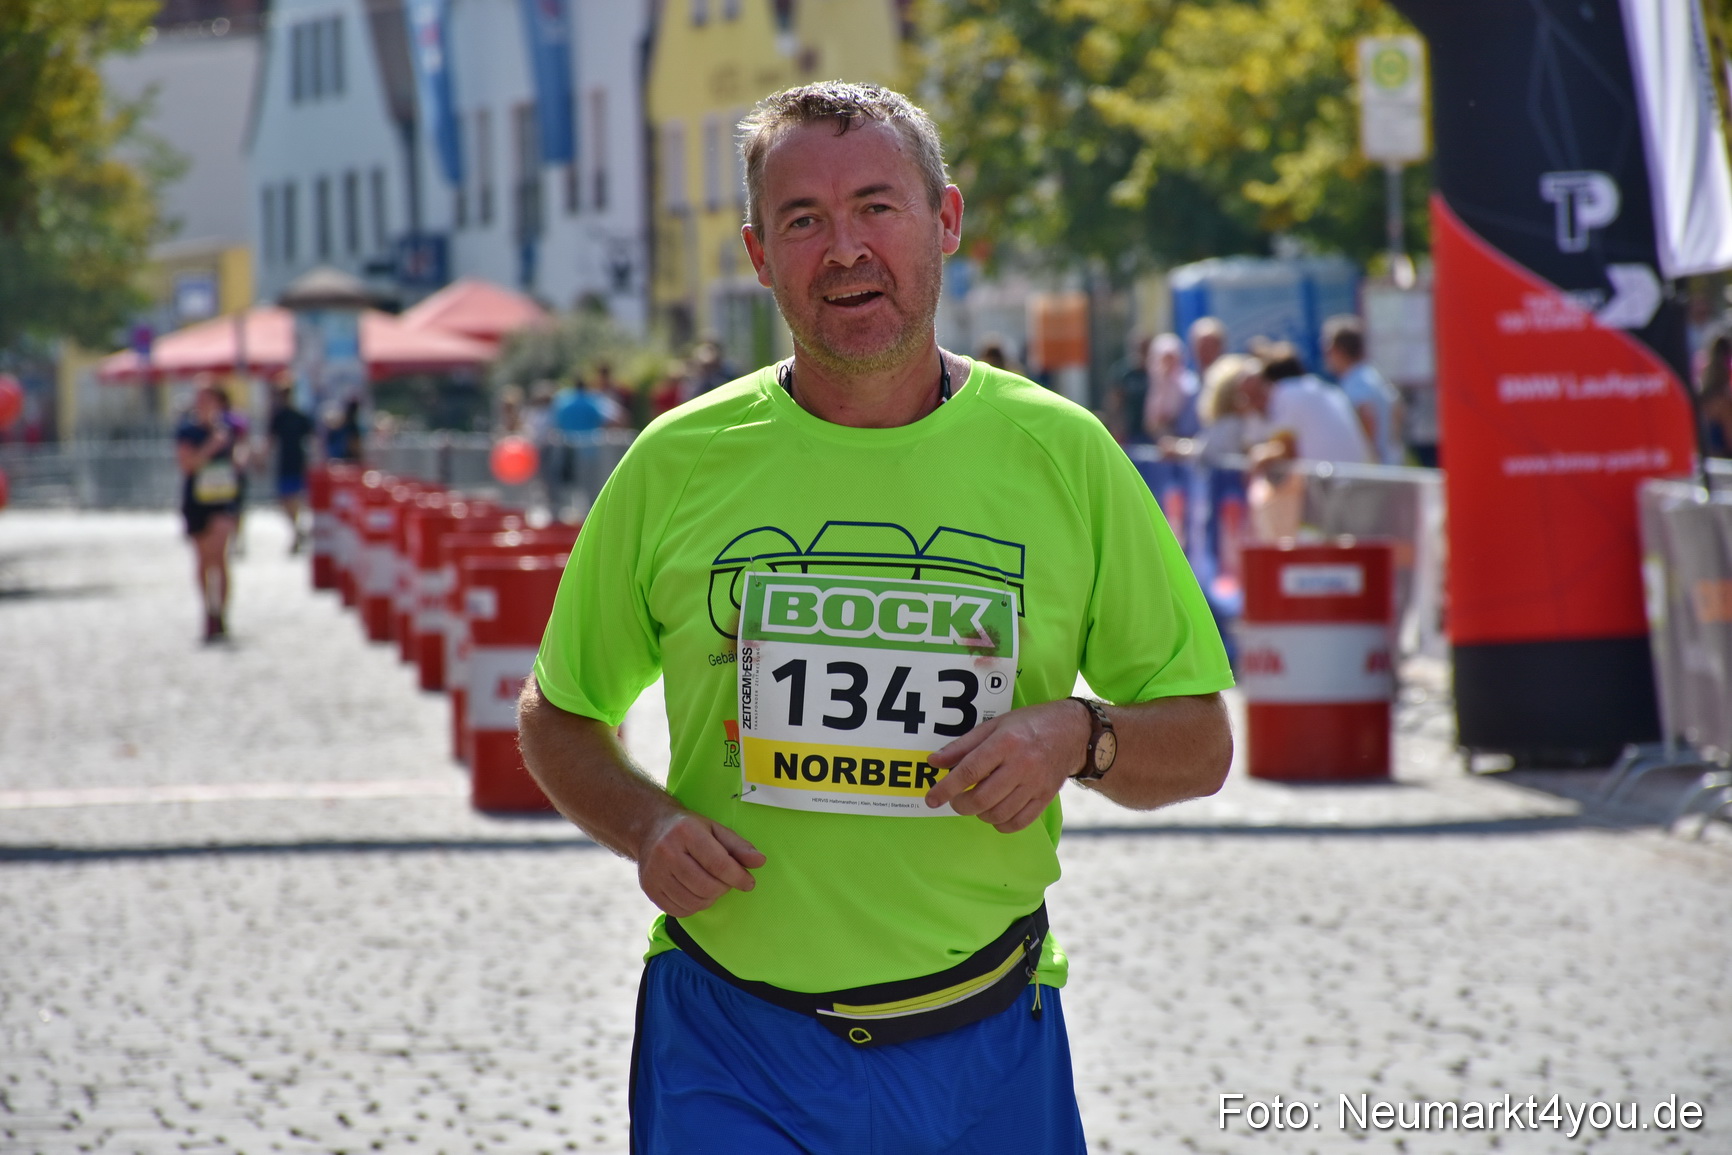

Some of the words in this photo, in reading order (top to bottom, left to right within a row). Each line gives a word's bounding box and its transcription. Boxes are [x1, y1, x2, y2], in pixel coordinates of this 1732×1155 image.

[761, 584, 997, 648] BOCK
[772, 658, 979, 737] 1343
[991, 676, 1002, 688] D
[774, 752, 957, 789] NORBER
